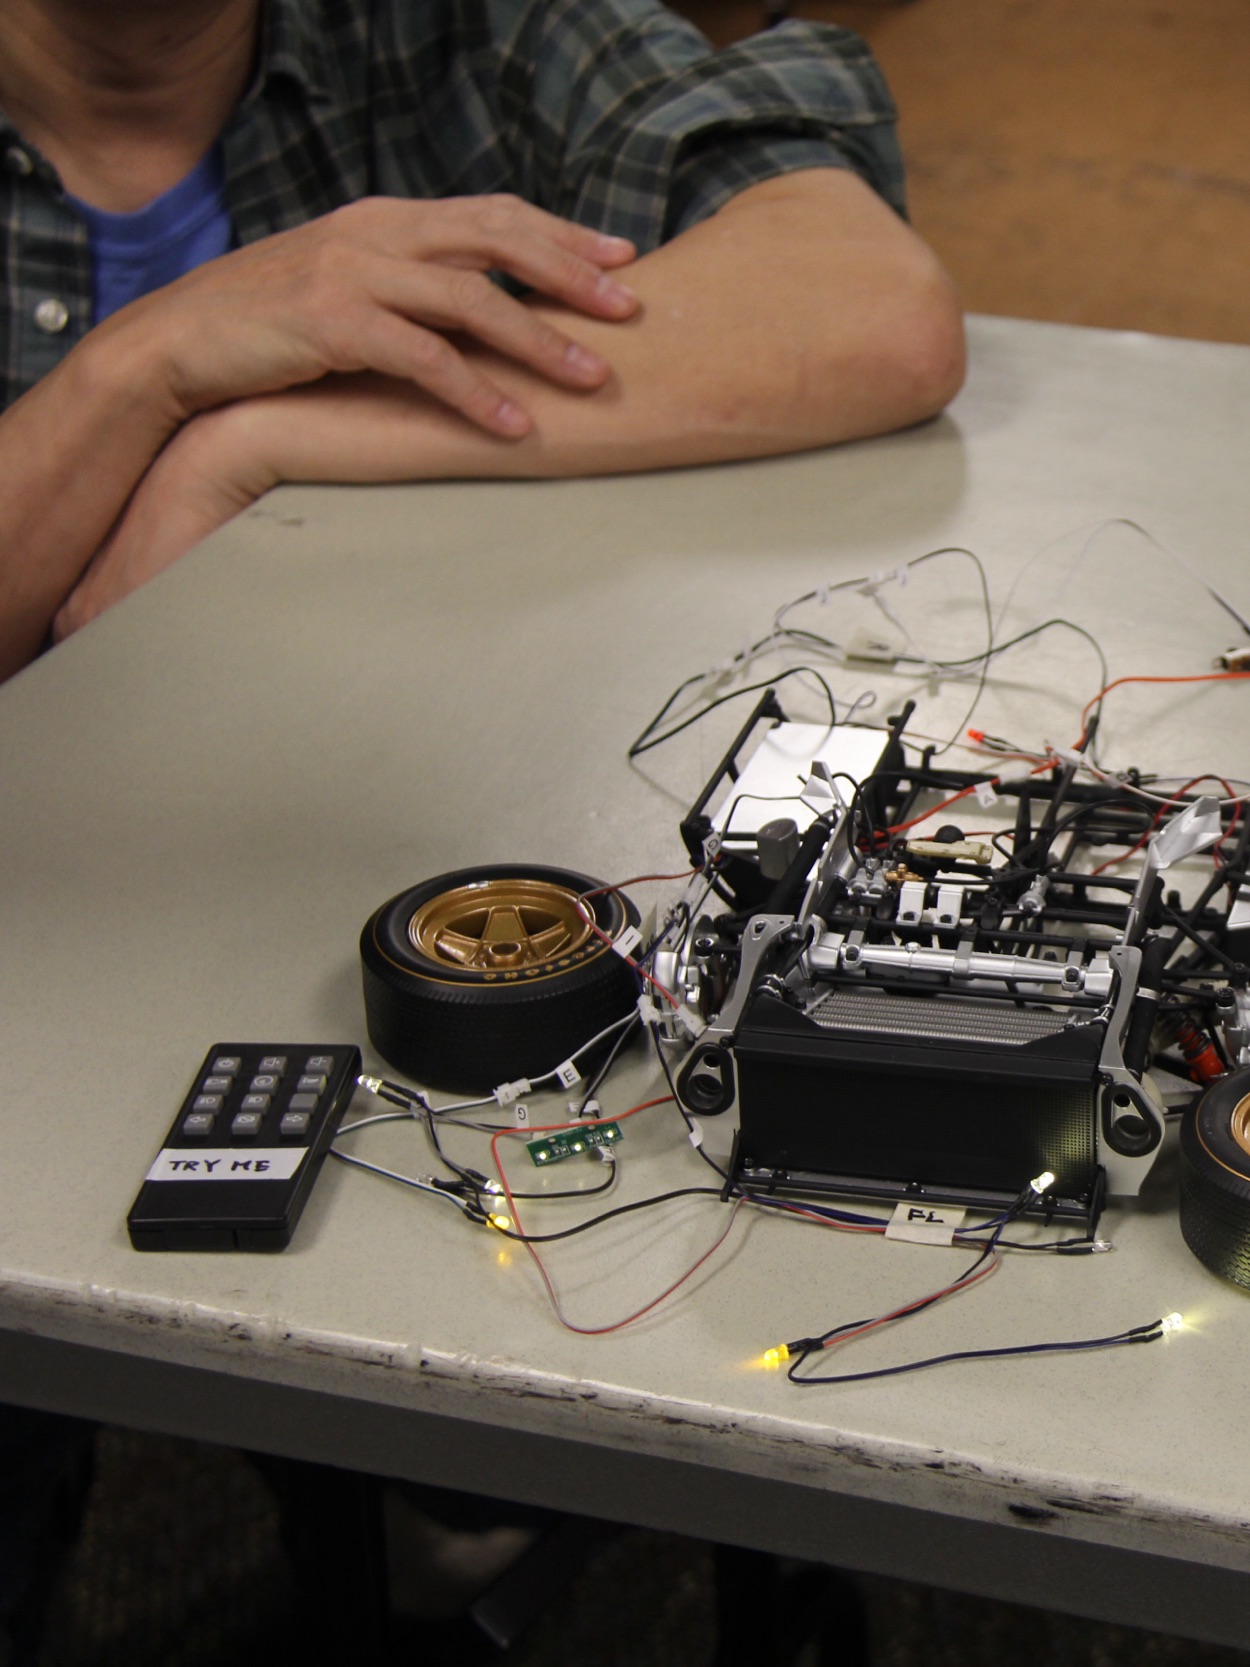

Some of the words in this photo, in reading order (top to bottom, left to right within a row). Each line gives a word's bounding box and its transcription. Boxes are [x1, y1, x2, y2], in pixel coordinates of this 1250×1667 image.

[563, 1068, 577, 1083] E
[169, 1159, 221, 1172] TRY
[231, 1160, 270, 1172] ME
[907, 1207, 945, 1223] FL
